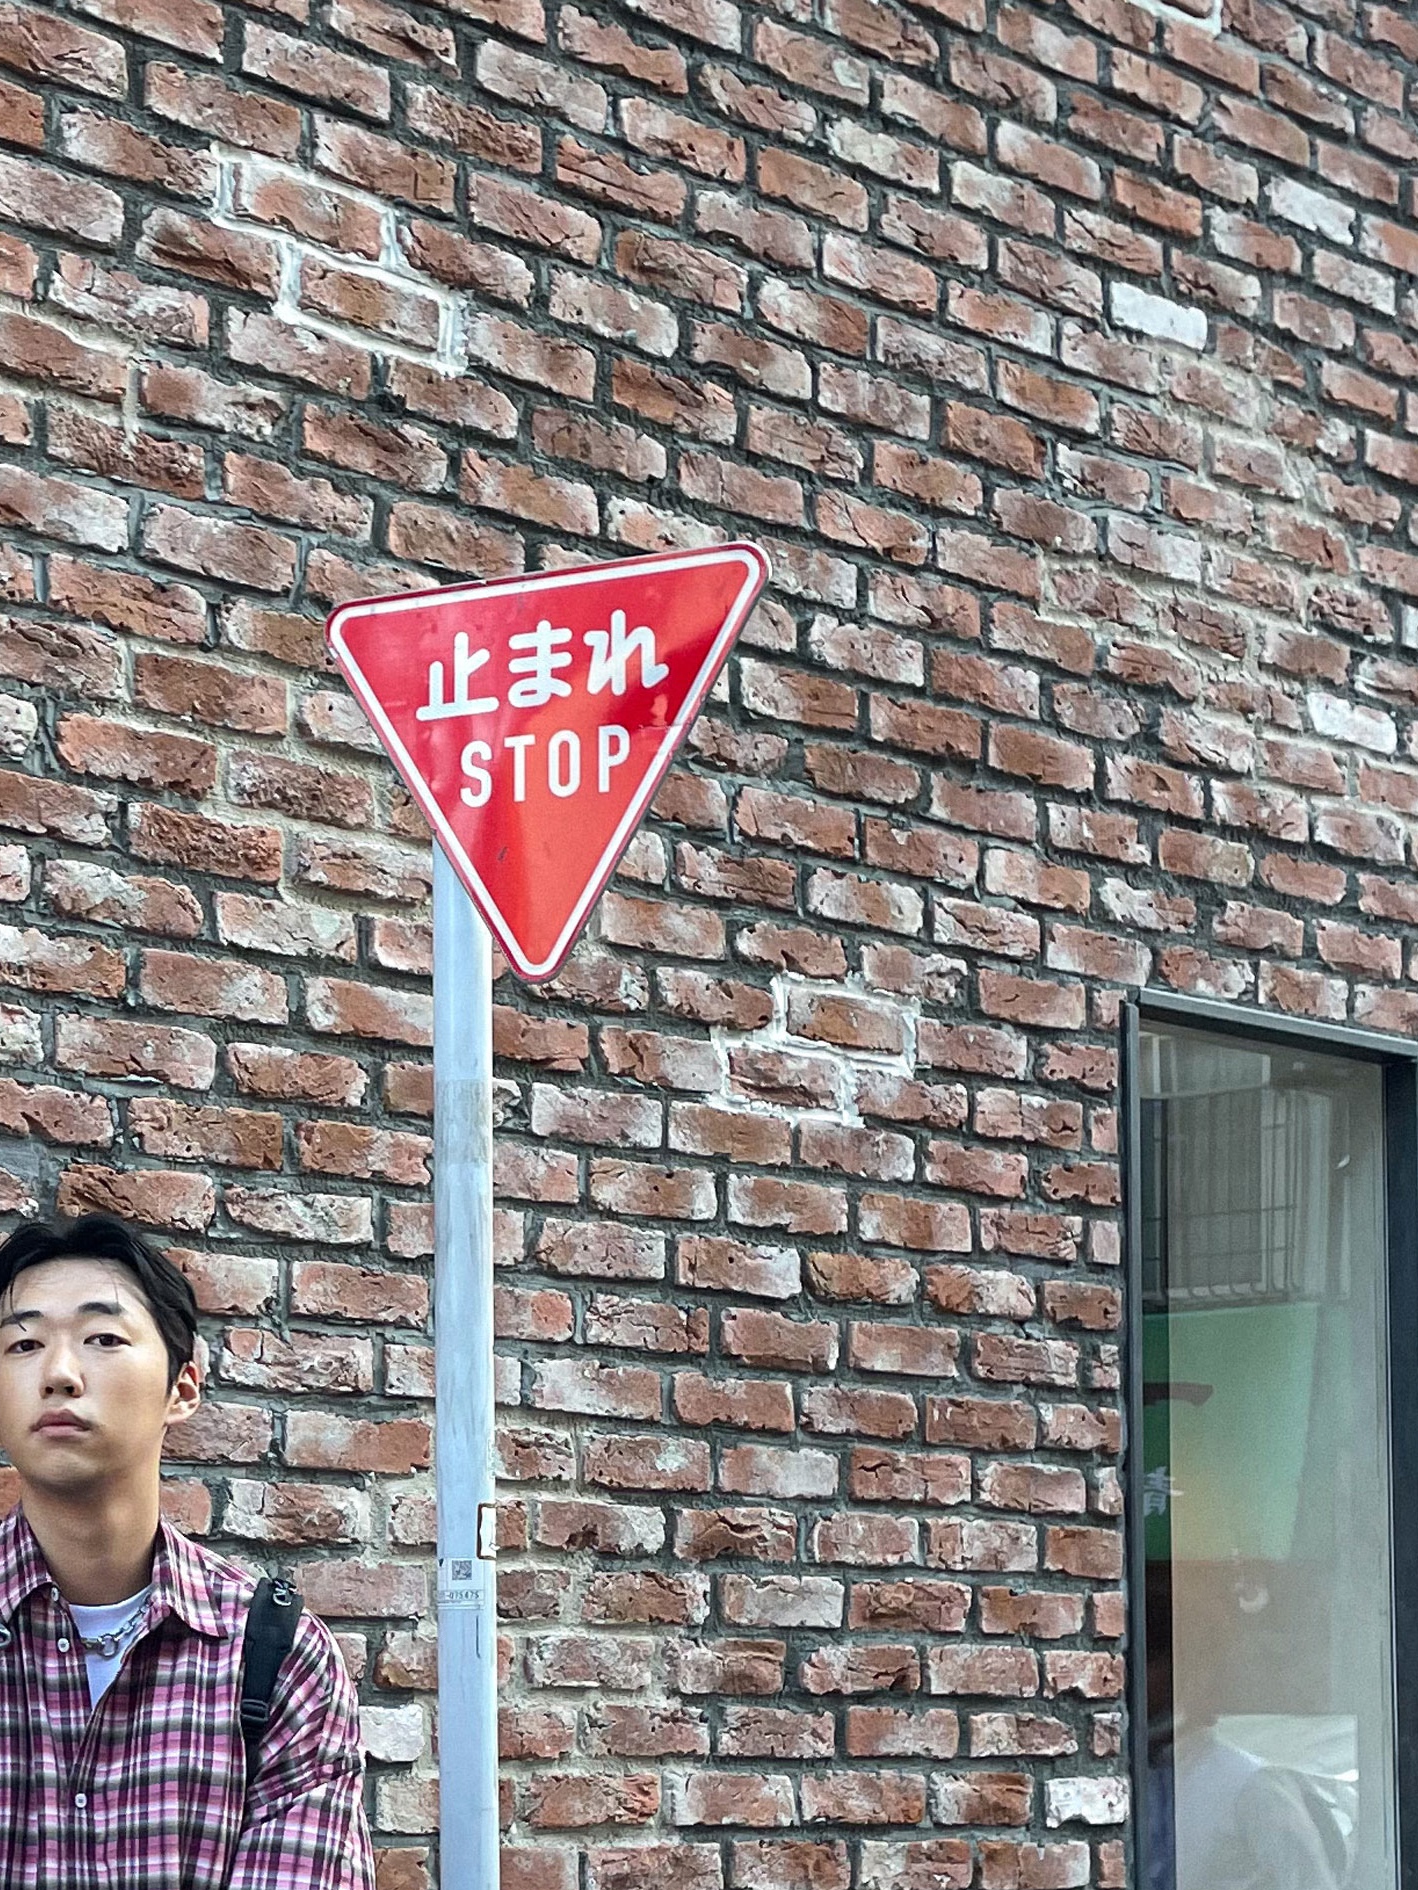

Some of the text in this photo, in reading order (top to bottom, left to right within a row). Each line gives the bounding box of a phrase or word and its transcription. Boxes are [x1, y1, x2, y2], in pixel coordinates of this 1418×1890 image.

[416, 609, 670, 721] 止まれ
[460, 724, 631, 808] STOP
